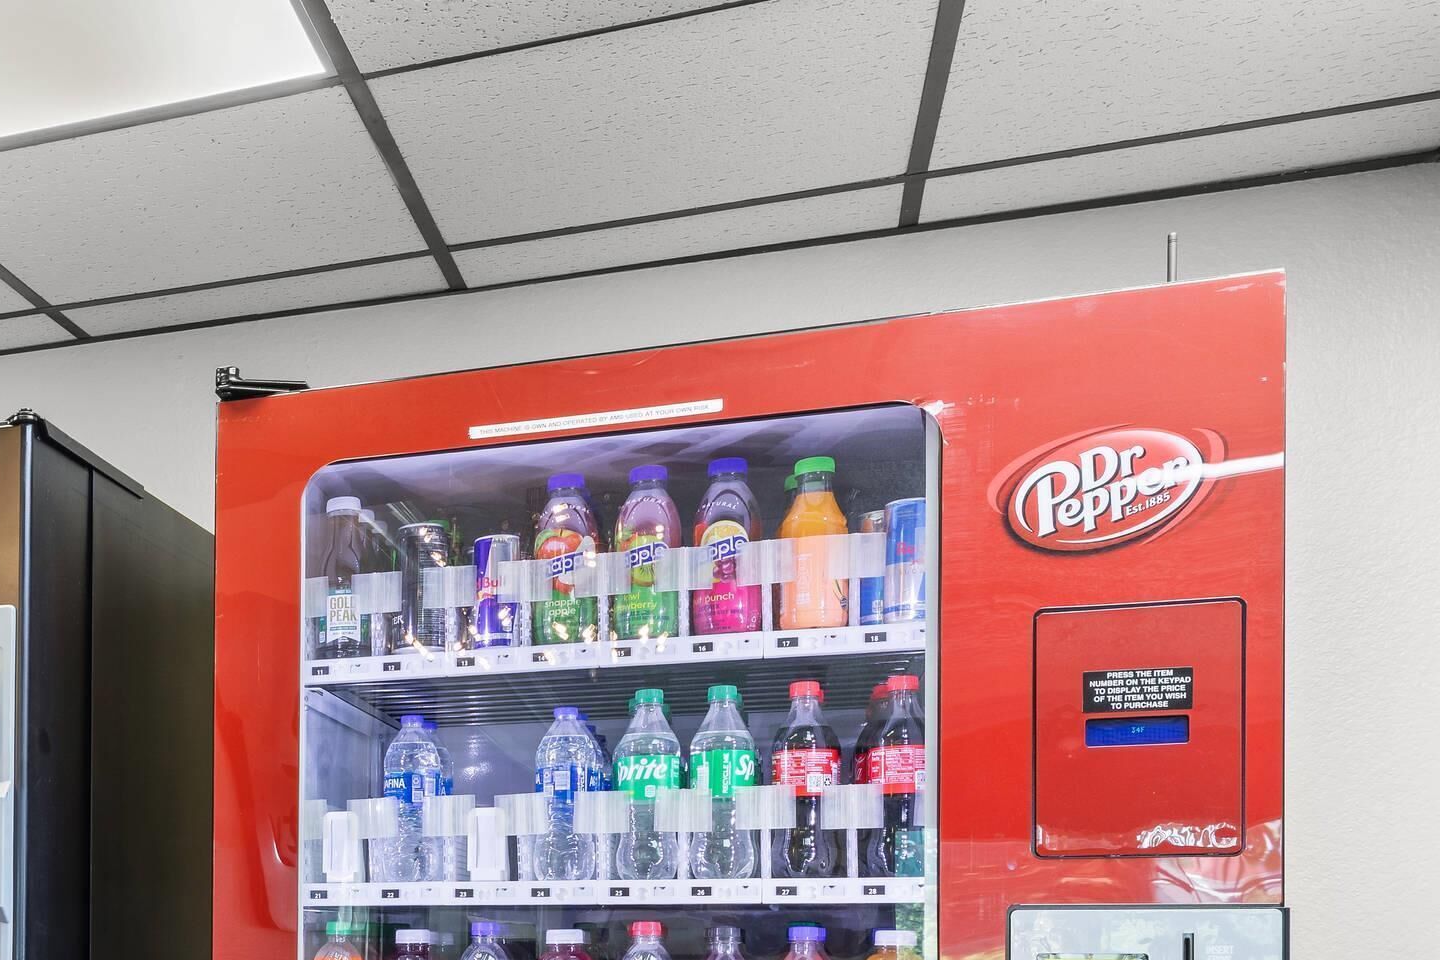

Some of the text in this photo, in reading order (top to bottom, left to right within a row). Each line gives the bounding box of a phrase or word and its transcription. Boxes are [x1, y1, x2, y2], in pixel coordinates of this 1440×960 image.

[495, 426, 522, 434] MACHINE
[531, 422, 548, 430] OWN
[548, 421, 561, 429] AND
[562, 418, 598, 427] OPERATED
[625, 412, 643, 420] USED
[655, 409, 675, 417] YOUR
[1078, 445, 1145, 492] Dr
[1015, 456, 1190, 538] Pepper
[704, 592, 735, 602] punch
[329, 609, 358, 623] PEAK
[1154, 669, 1174, 677] ITEM
[1089, 679, 1124, 688] NUMBER
[1140, 677, 1157, 685] THE
[1158, 676, 1192, 684] KEYPAD
[1094, 684, 1186, 695] TO DISPLAY THE PRICE
[1093, 691, 1187, 703] OF THE ITEM YOU WISH
[1110, 700, 1169, 710] TO PURCHASE
[385, 777, 406, 789] AFINA
